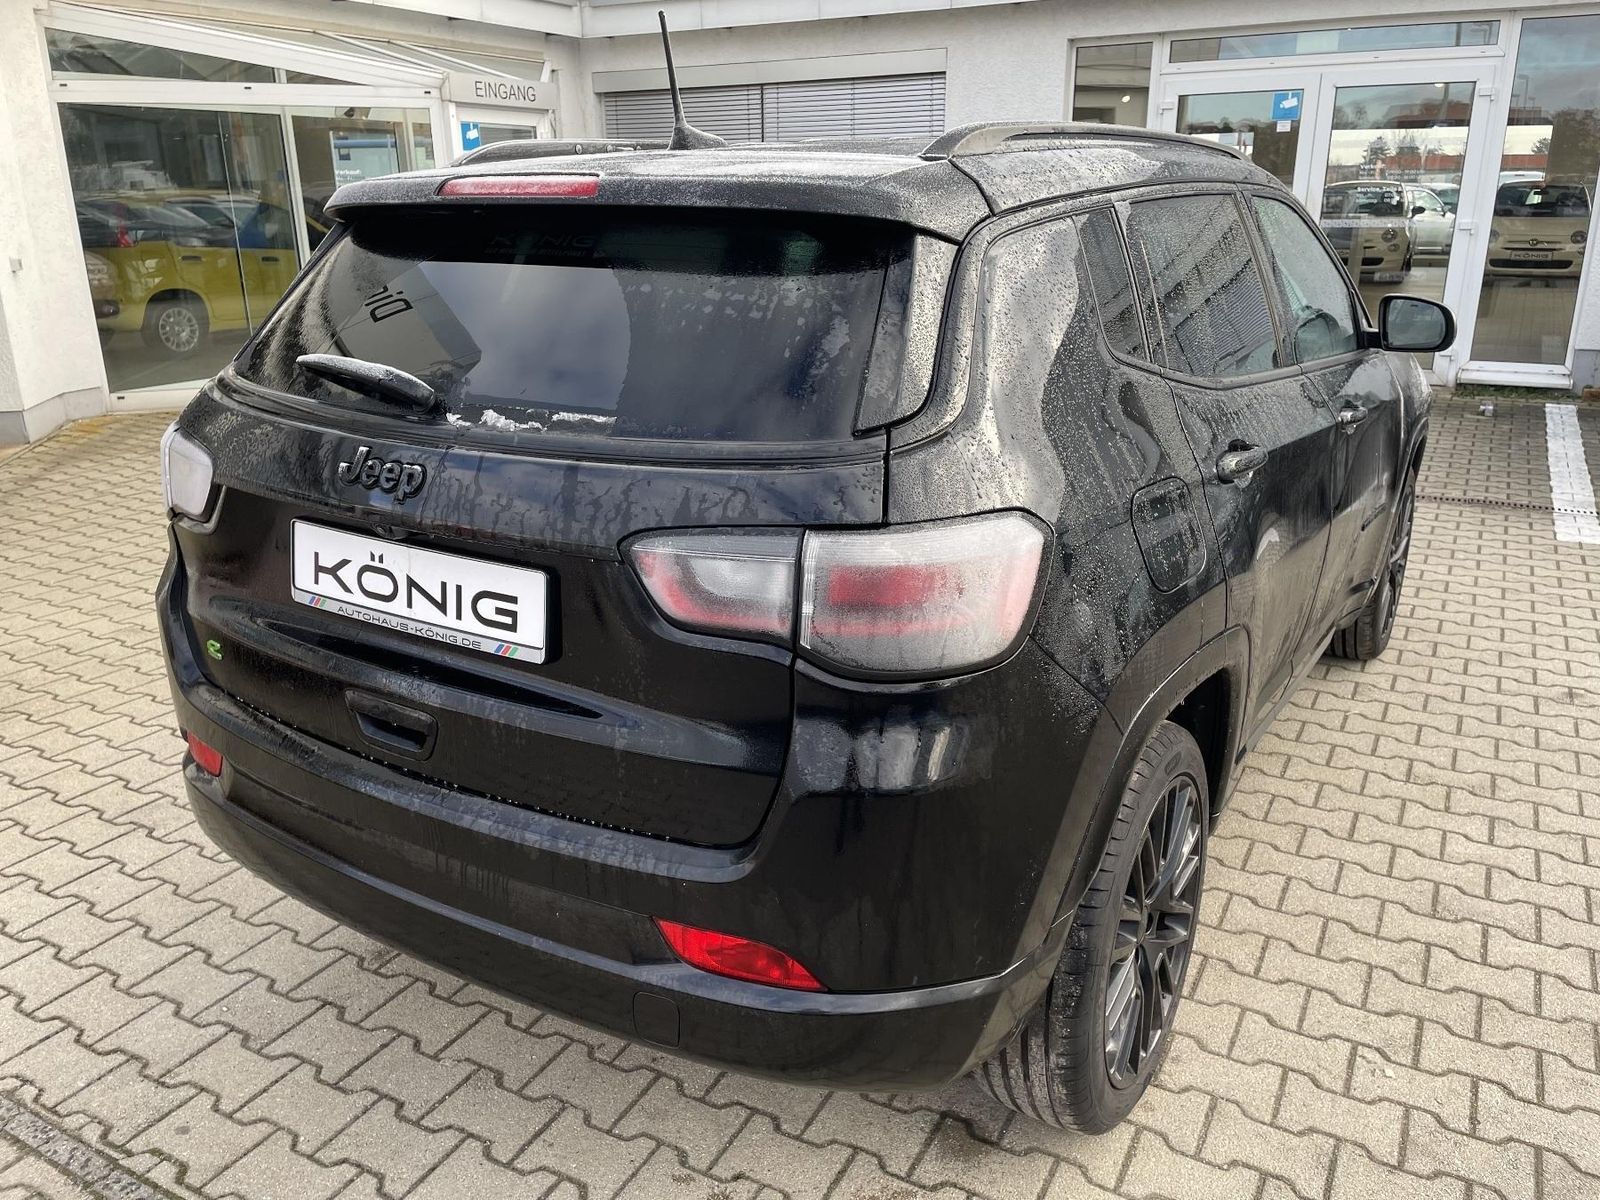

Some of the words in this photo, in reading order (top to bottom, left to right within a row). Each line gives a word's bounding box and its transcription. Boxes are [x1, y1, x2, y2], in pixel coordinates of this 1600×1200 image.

[475, 81, 536, 102] EINGANG
[337, 446, 427, 505] Jeep
[313, 550, 518, 634] KÖNIG
[336, 605, 482, 650] AUTOHAUS-KÖNIG.DE
